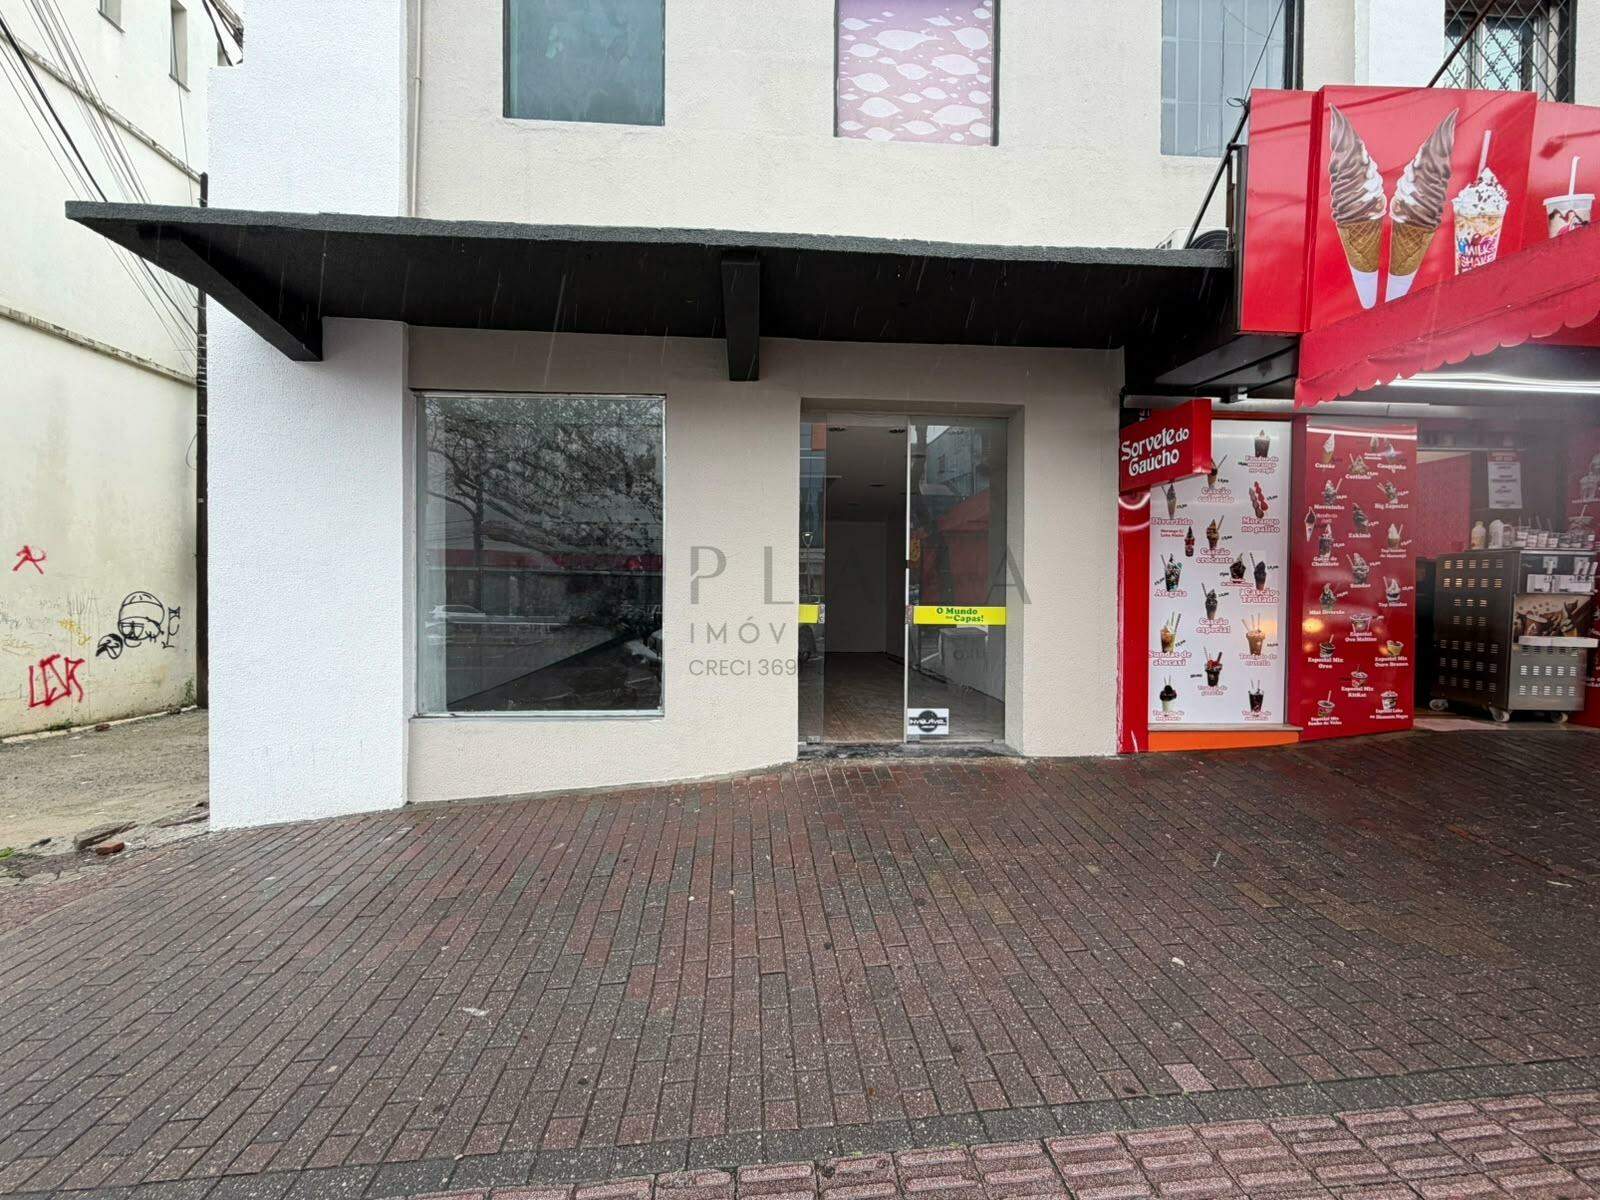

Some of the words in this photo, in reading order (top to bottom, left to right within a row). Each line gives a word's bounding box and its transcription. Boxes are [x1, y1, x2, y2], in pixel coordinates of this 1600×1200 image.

[1121, 427, 1175, 461] Sorvete
[1175, 428, 1190, 442] do
[1128, 449, 1180, 476] Gaúcho
[1151, 517, 1193, 525] Divertido
[1241, 516, 1280, 526] Morango
[1241, 525, 1253, 533] no
[1253, 524, 1280, 534] palito
[1200, 547, 1231, 556] Cascão
[1196, 556, 1233, 564] crocante
[1241, 596, 1279, 604] Trufado
[936, 607, 944, 615] O
[953, 614, 984, 623] Capas!
[1199, 618, 1230, 626] Cascão
[1196, 625, 1231, 634] especial
